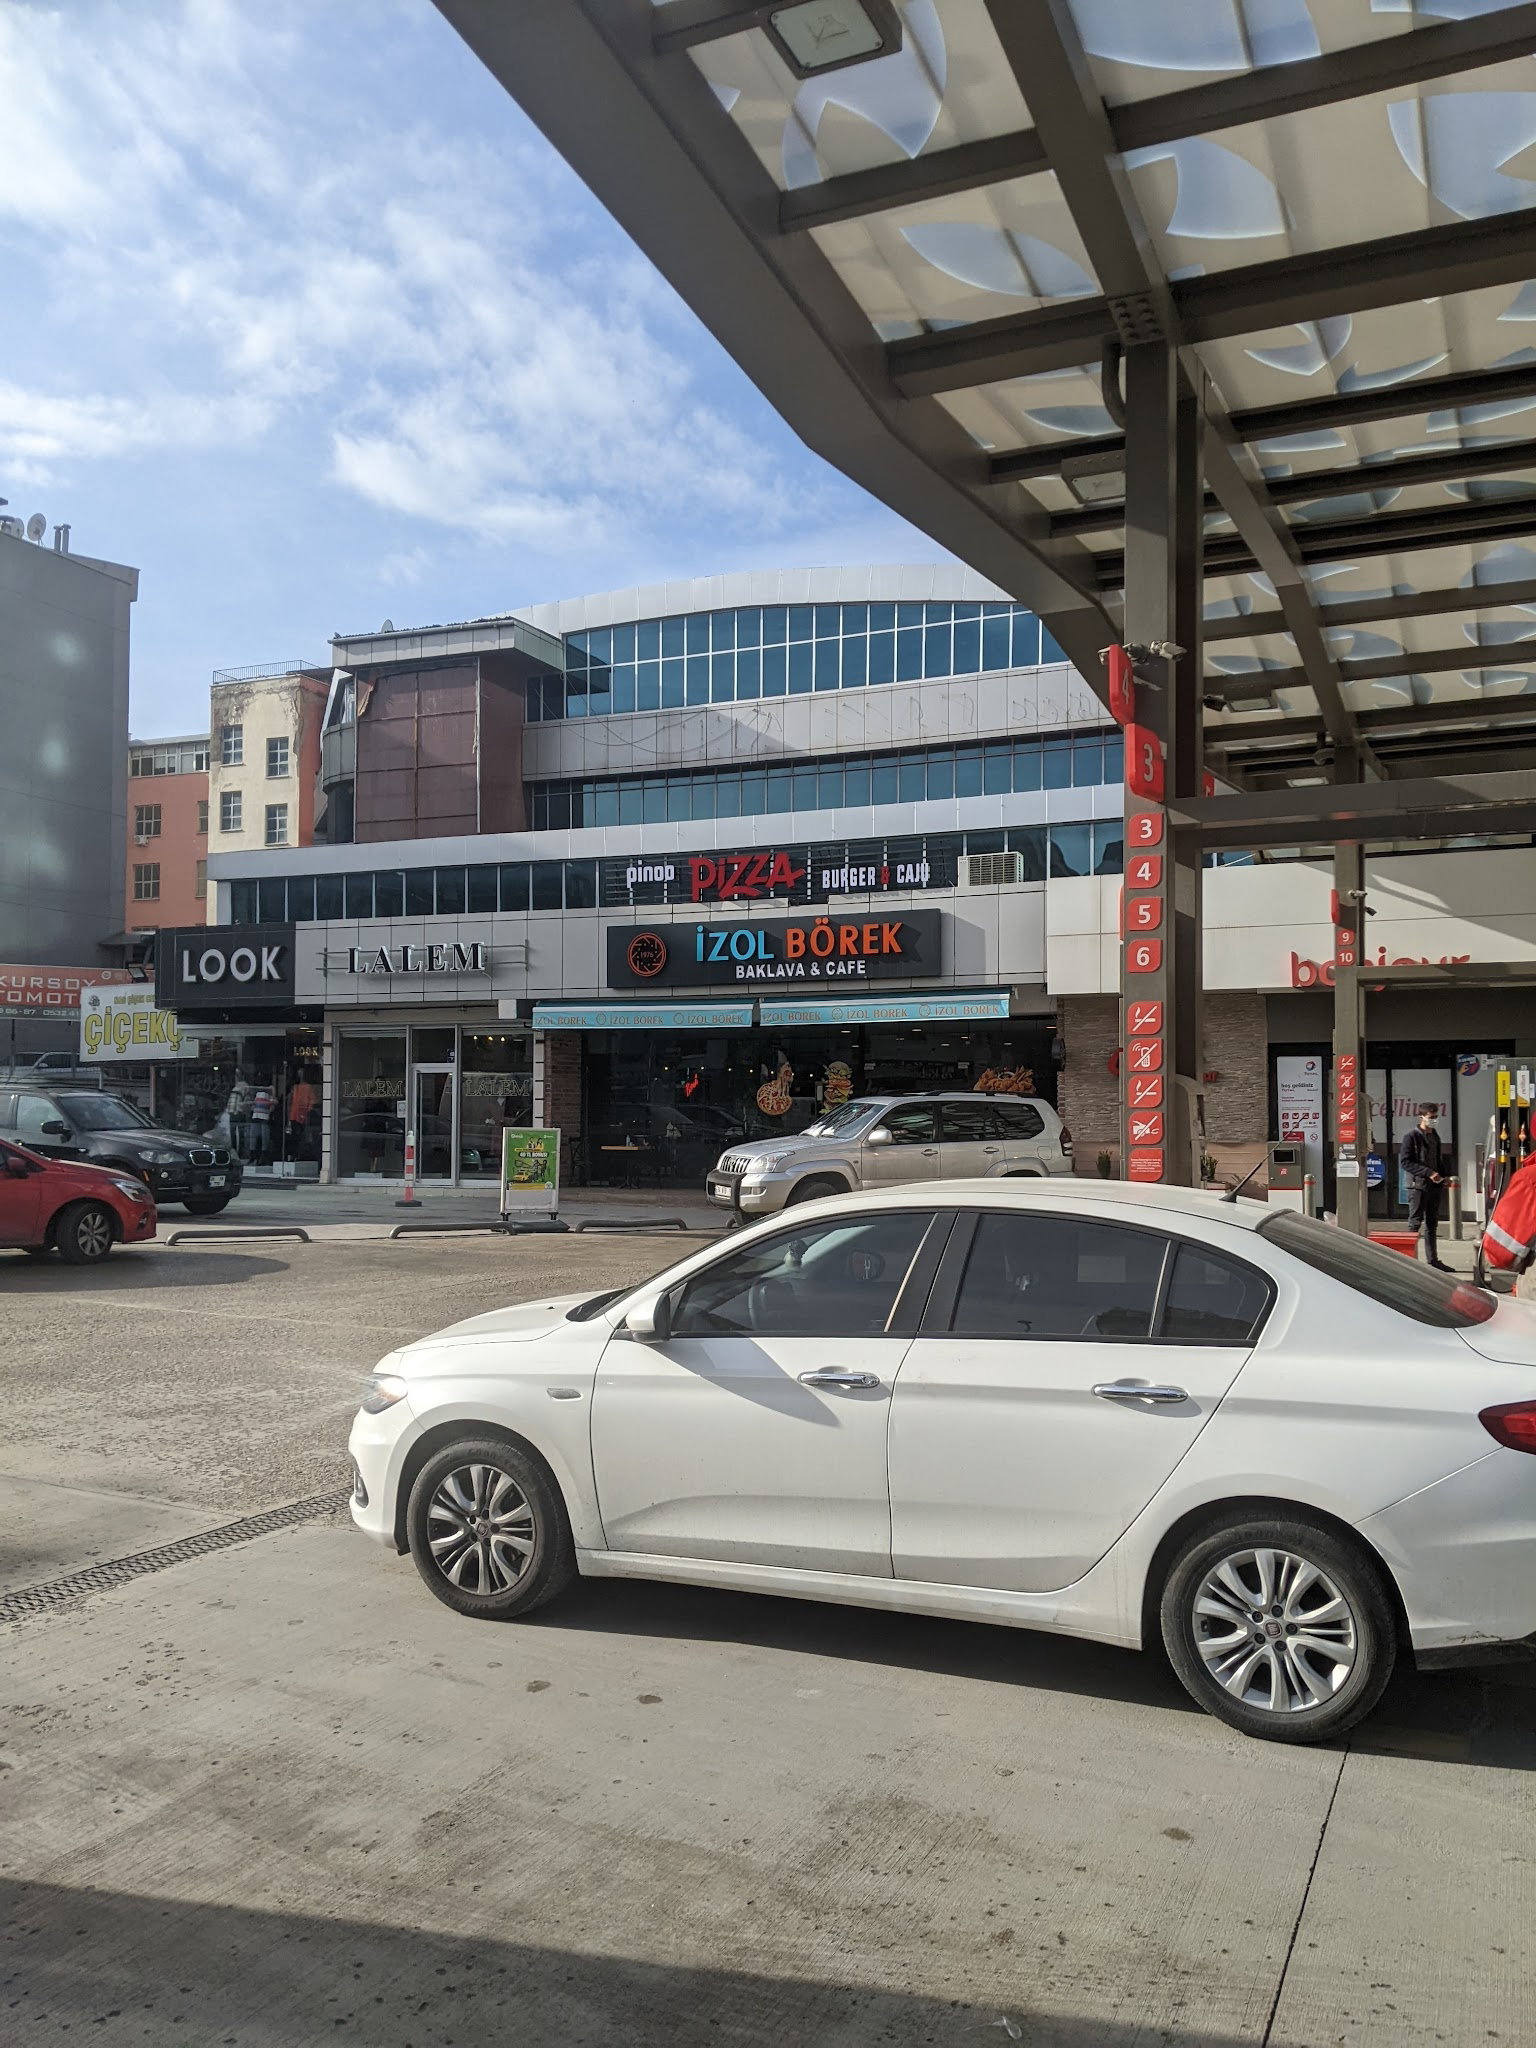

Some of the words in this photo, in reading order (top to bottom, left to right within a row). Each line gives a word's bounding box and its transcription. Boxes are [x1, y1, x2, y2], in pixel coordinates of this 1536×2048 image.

[1122, 668, 1129, 704] 4
[1143, 743, 1154, 782] 3
[1140, 819, 1153, 839] 3
[822, 867, 876, 889] BURGER
[896, 863, 929, 884] CAJU
[1136, 861, 1152, 881] 4
[1138, 904, 1151, 924] 5
[696, 926, 774, 961] İZOL
[787, 917, 903, 958] BÖREK
[1342, 932, 1350, 942] 9
[182, 946, 281, 982] LOOK
[346, 942, 485, 974] LALEM
[1136, 947, 1150, 966] 6
[1339, 952, 1353, 963] 10
[735, 963, 805, 979] BAKLAVA
[810, 963, 822, 976] &
[826, 960, 866, 975] CAFE
[293, 1046, 318, 1056] LOOK
[343, 1081, 404, 1097] LALEM
[465, 1080, 529, 1096] LALEM
